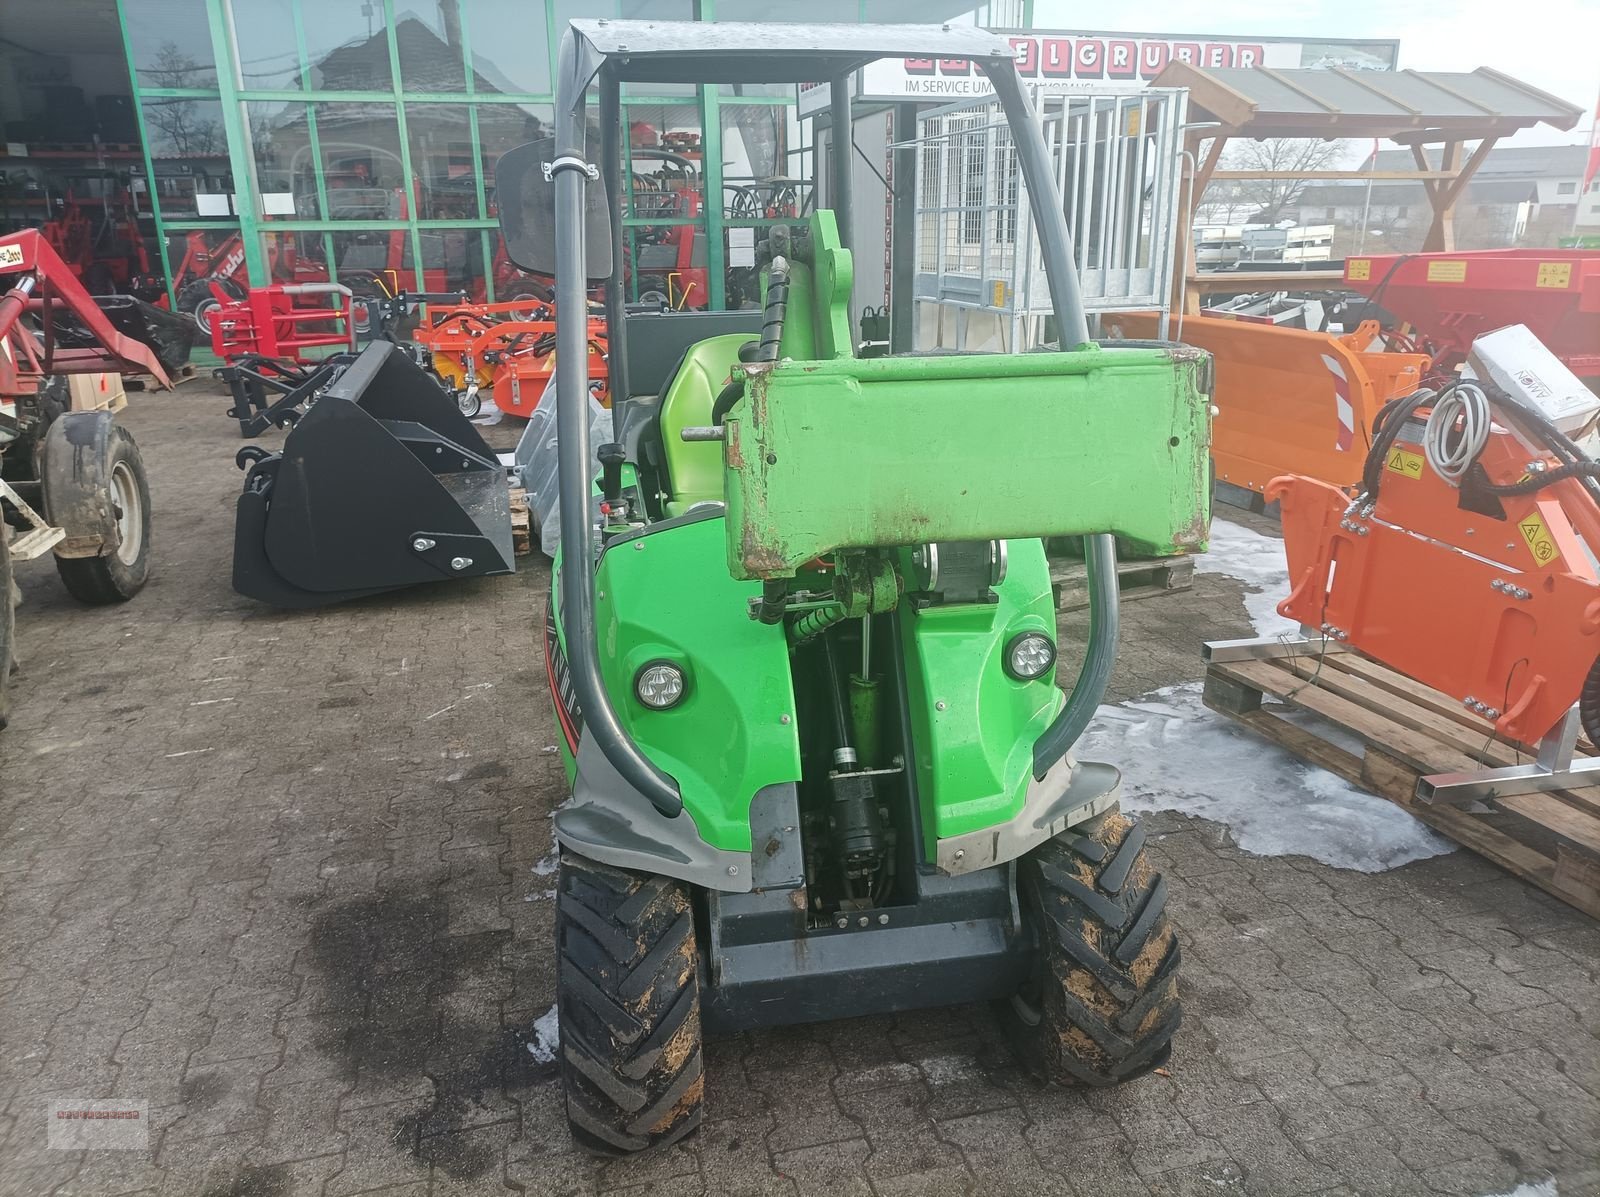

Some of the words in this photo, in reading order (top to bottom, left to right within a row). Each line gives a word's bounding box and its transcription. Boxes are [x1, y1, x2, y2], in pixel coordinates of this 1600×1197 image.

[906, 40, 1258, 70] ELGRUBER
[905, 80, 919, 93] IM
[922, 81, 970, 94] SERVICE
[972, 83, 993, 94] UM
